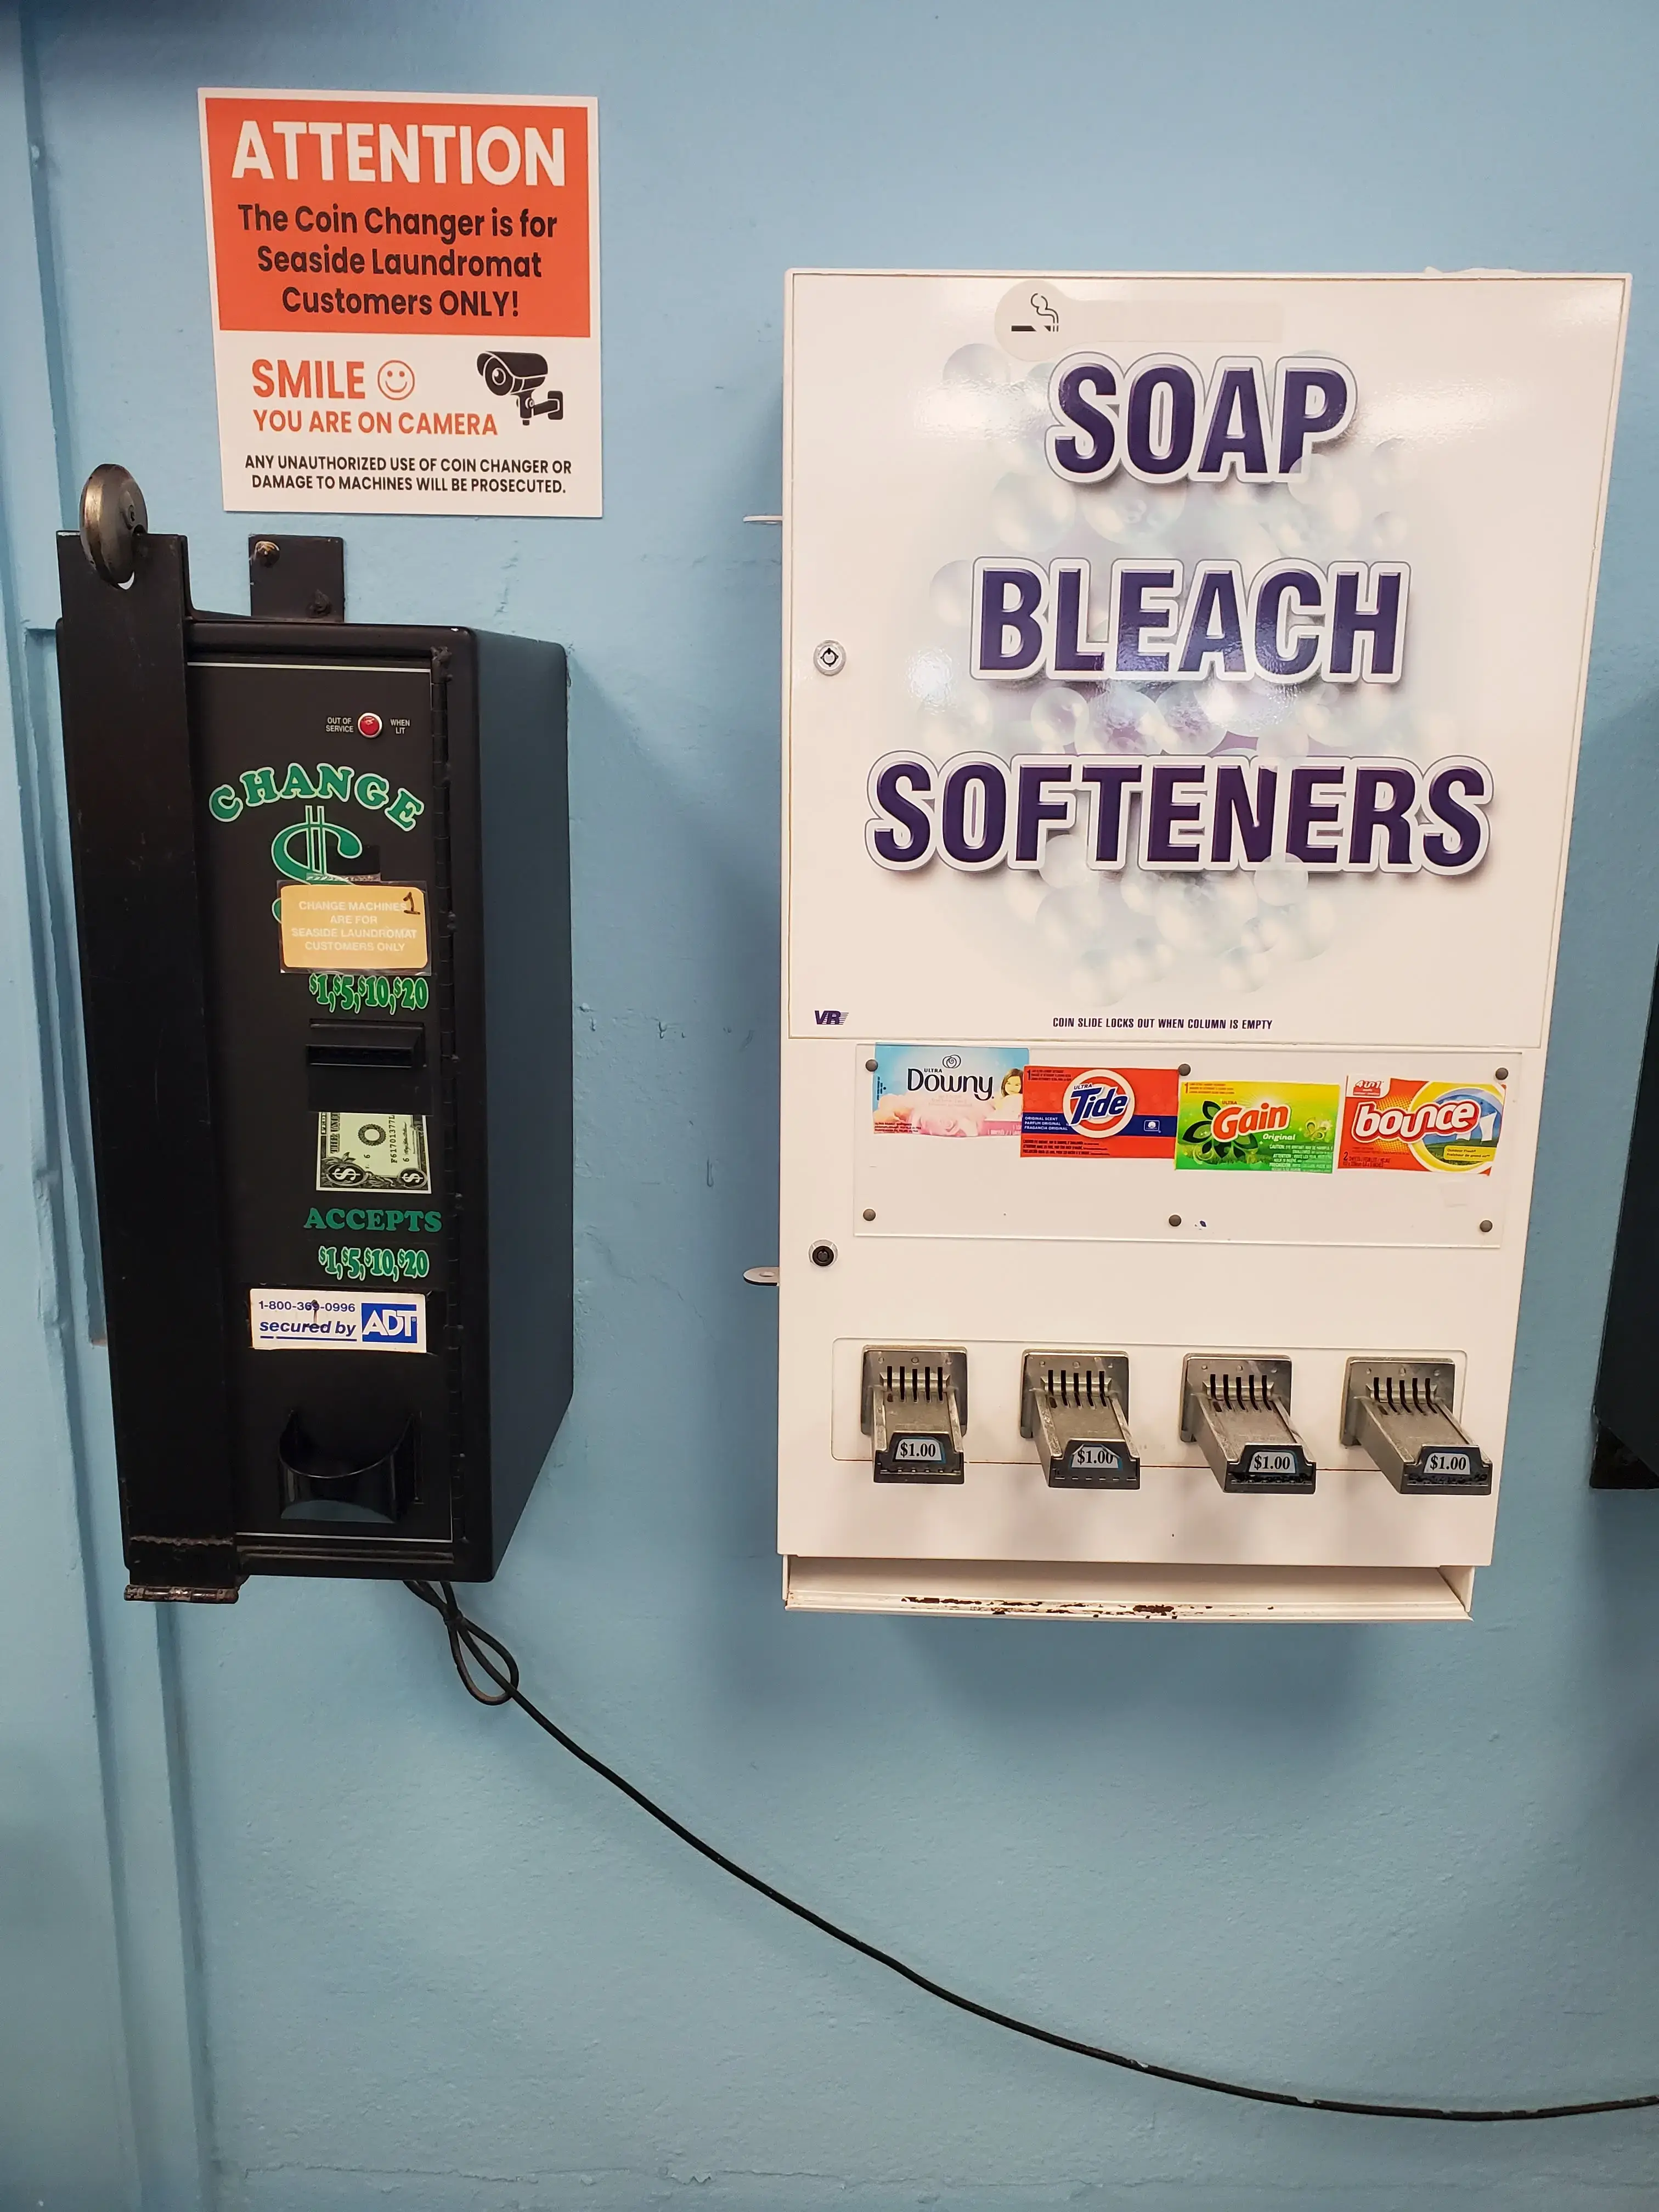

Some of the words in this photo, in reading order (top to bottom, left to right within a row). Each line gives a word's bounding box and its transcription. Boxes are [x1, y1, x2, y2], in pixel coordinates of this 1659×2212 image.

[231, 120, 565, 187] ATTENTION
[238, 204, 289, 232] The
[295, 203, 358, 233] Coin
[364, 206, 485, 245] Changer
[492, 207, 513, 236] is
[520, 208, 558, 238] for
[257, 244, 365, 273] Seaside
[372, 249, 542, 277] Laundromat
[282, 286, 432, 315] Customers
[439, 290, 518, 317] ONLY!
[251, 359, 366, 399] SMILE
[253, 409, 302, 432] YOU
[308, 410, 352, 433] ARE
[358, 411, 392, 433] ON
[398, 411, 499, 436] CAMERA
[1052, 360, 1350, 476] SOAP
[245, 455, 274, 469] ANY
[277, 455, 387, 471] UNAUTHORIZED
[390, 458, 415, 471] USE
[419, 458, 437, 472] OF
[441, 458, 476, 472] COIN
[480, 459, 549, 474] CHANGER
[552, 460, 572, 474] OR
[252, 475, 313, 489] DAMAGE
[316, 476, 335, 489] TO
[338, 476, 413, 490] MACHINES
[416, 477, 448, 492] WILL
[451, 478, 468, 492] BE
[471, 478, 567, 493] PROSECUTED.
[977, 565, 1403, 678] BLEACH
[325, 725, 354, 733] SERVICE
[327, 716, 341, 725] OUT
[342, 717, 352, 725] OF
[390, 719, 410, 727] WHEN
[208, 762, 425, 832] CHANGE
[873, 758, 1488, 869] SOFTENERS
[298, 900, 346, 911] CHANGE
[348, 901, 407, 912] MACHINES
[403, 891, 421, 915] 1
[330, 915, 352, 924] ARE
[354, 915, 377, 924] FOR
[291, 927, 337, 938] SEASIDE
[341, 928, 417, 939] LAUNDROMAT
[304, 941, 375, 951] CUSTOMERS
[376, 942, 405, 952] ONLY
[1053, 1017, 1074, 1028] COIN
[1077, 1018, 1103, 1028] SLIDE
[1105, 1018, 1134, 1028] LOCKS
[1137, 1018, 1155, 1028] OUT
[1158, 1019, 1184, 1029] WHEN
[1187, 1019, 1226, 1029] COLUMN
[1229, 1019, 1239, 1029] IS
[1242, 1019, 1273, 1030] EMPTY
[907, 1068, 994, 1101] Downy
[1070, 1086, 1129, 1125] Tide
[1212, 1102, 1290, 1141] Gain
[1355, 1102, 1477, 1140] bounce
[1262, 1133, 1296, 1142] Original
[1343, 1151, 1348, 1161] 2
[303, 1207, 442, 1233] ACCEPTS
[259, 1321, 331, 1334] secured
[335, 1321, 357, 1338] by
[362, 1308, 417, 1338] ADT
[900, 1441, 936, 1458] $1.00
[1076, 1449, 1114, 1465] $1.00
[1254, 1454, 1290, 1470] $1.00
[1430, 1454, 1466, 1470] $1.00
